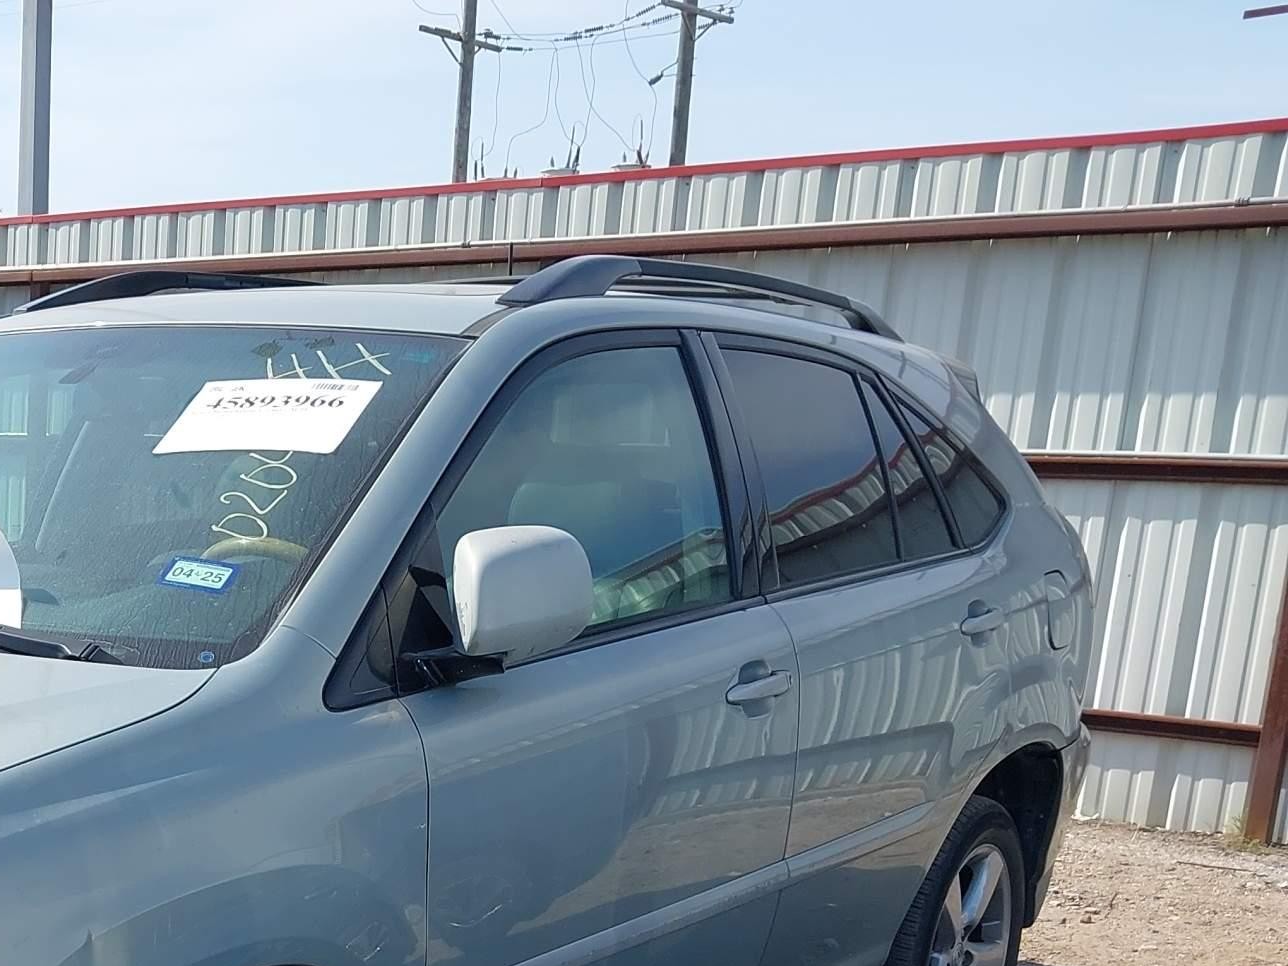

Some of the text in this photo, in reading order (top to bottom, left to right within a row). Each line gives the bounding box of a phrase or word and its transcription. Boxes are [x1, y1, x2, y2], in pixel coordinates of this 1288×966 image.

[206, 395, 346, 410] 45893966
[172, 567, 194, 578] 04
[200, 572, 225, 583] 25
